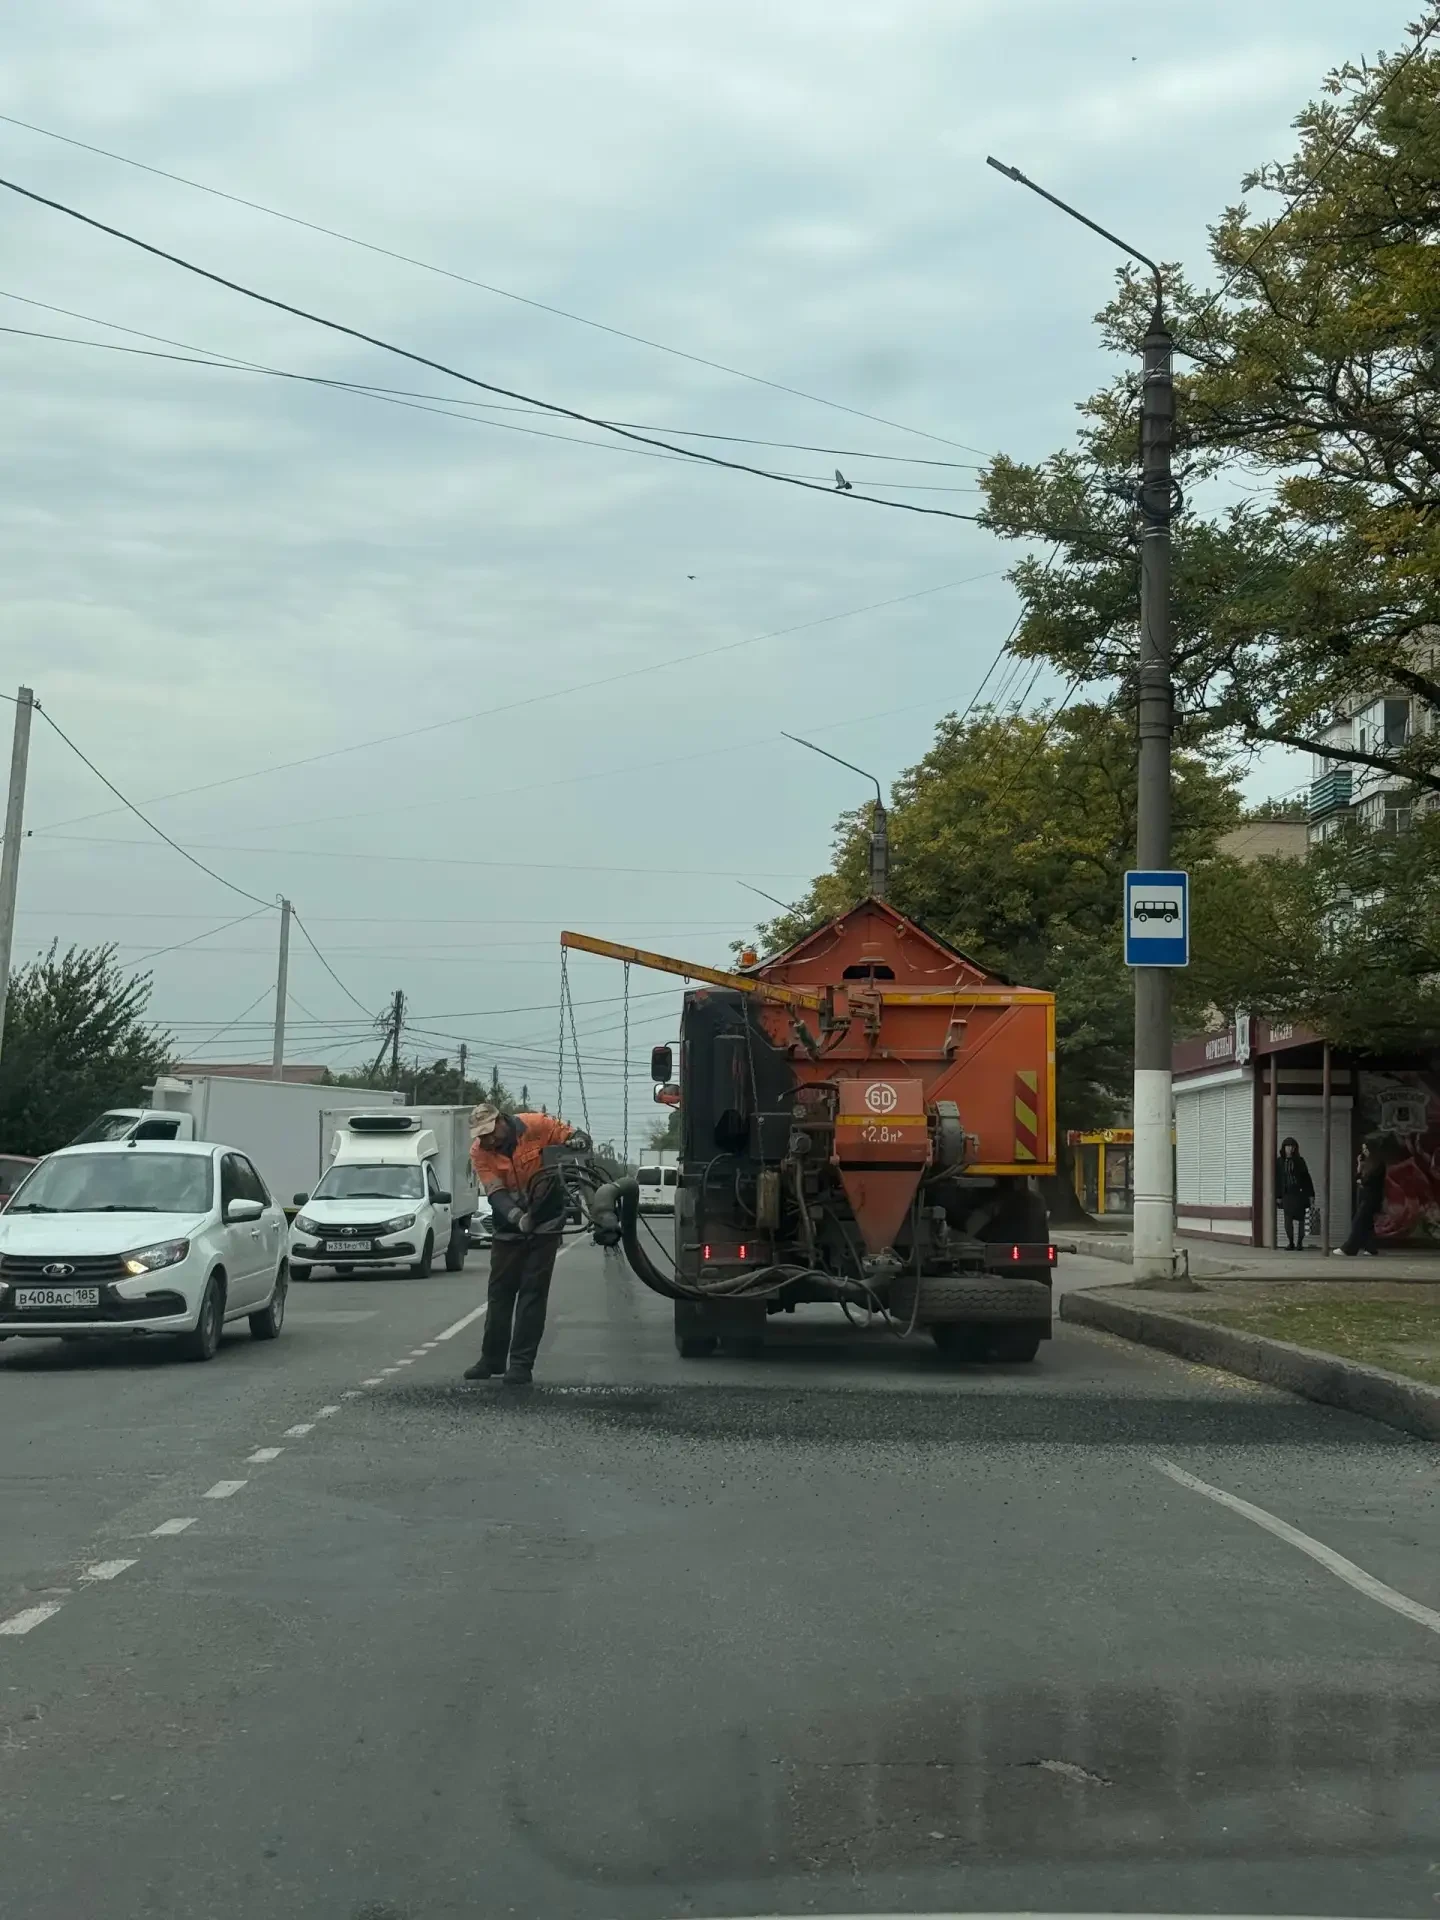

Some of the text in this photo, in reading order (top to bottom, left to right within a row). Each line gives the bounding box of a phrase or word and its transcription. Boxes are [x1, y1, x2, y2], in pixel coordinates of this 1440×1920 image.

[870, 1090, 892, 1106] 60
[19, 1289, 97, 1305] В408АС 185
